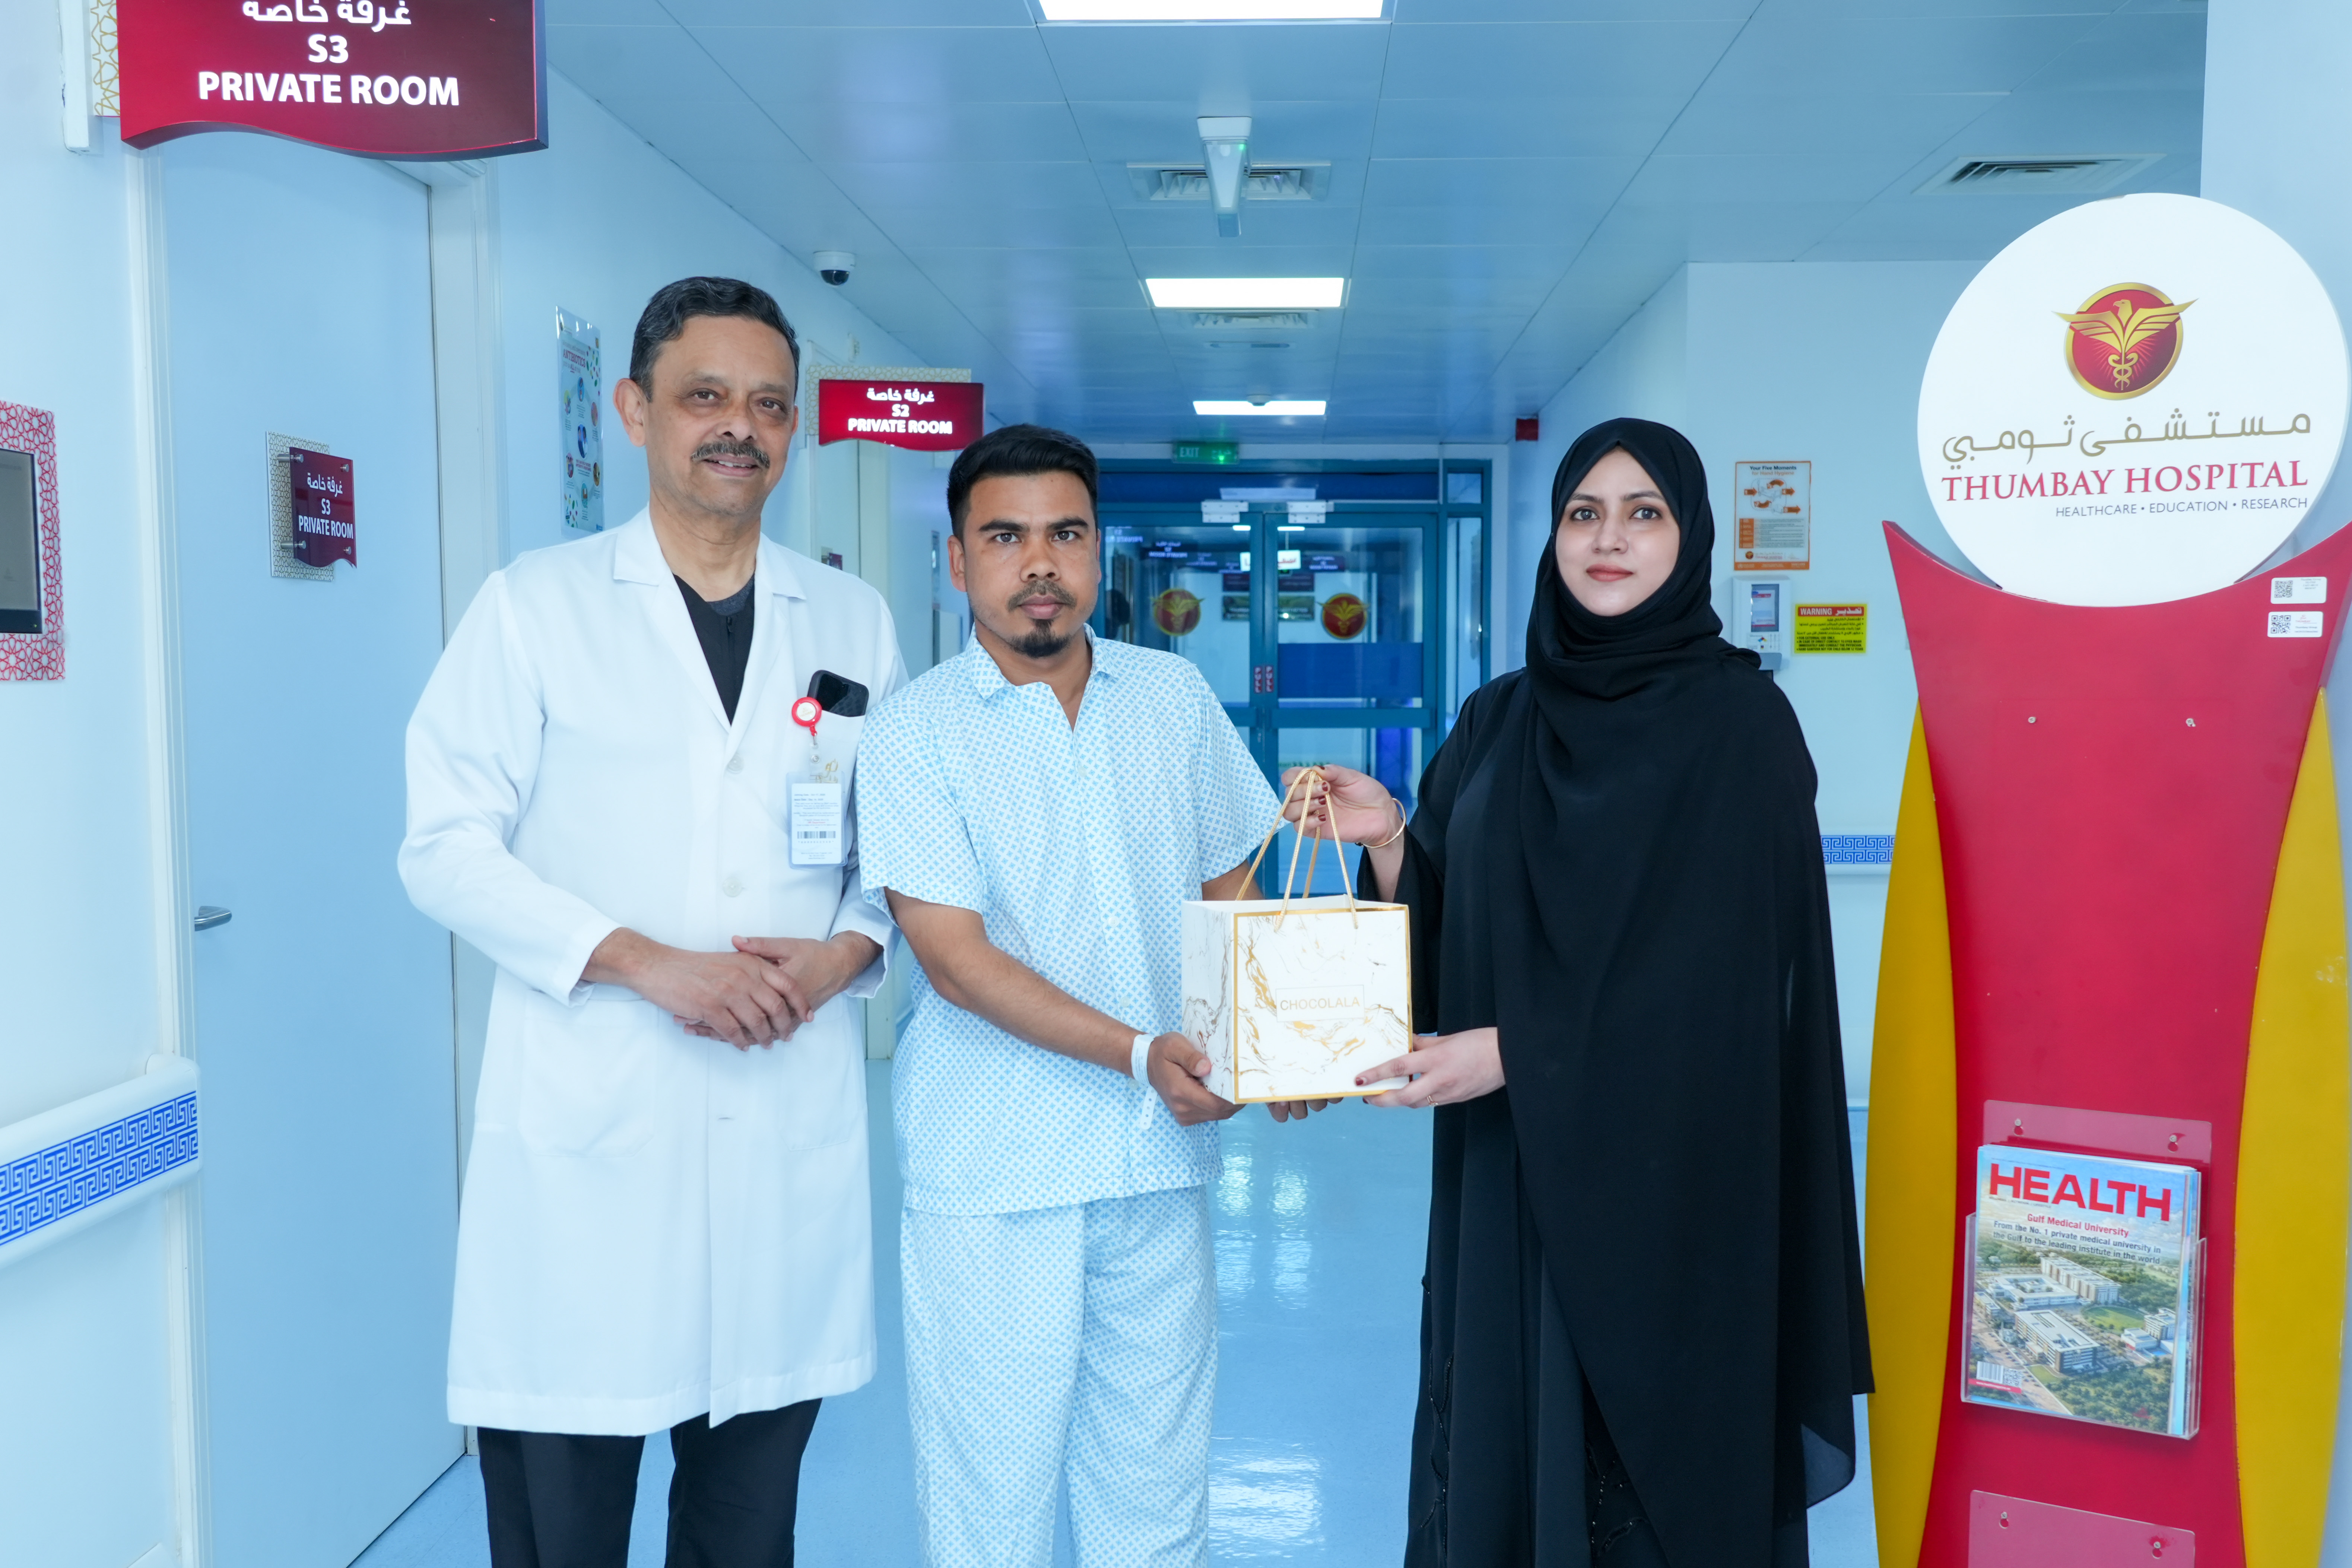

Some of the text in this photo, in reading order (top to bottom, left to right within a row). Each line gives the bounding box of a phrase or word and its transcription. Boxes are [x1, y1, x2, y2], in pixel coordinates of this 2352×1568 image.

[308, 34, 349, 63] S3
[198, 72, 459, 105] PRIVATE ROOM
[563, 349, 586, 368] ANTIBIOTICS
[867, 387, 934, 405] غرفة خاصة
[892, 404, 910, 417] S2
[848, 418, 953, 434] PRIVATE ROOM
[1942, 408, 2310, 470] مستشفى ثومبي
[1180, 447, 1199, 458] EXIT
[307, 472, 343, 497] غرفة خاصة
[1941, 460, 2308, 501] THUMBAY HOSPITAL
[321, 498, 331, 515] S3
[2056, 497, 2308, 517] HEALTHCARE EDUCATION RESEARCH
[299, 515, 353, 539] PRIVATE ROOM
[1835, 607, 1862, 616] تحذير
[1280, 996, 1360, 1010] CHOCOLALA
[1990, 1163, 2171, 1222] HEALTH
[1994, 1221, 2012, 1230] From
[2029, 1226, 2041, 1234] No.
[2051, 1231, 2078, 1240] private
[2080, 1234, 2110, 1245] medical
[2113, 1240, 2151, 1253] university
[2028, 1213, 2129, 1238] Gulf Medical University
[2007, 1233, 2022, 1242] Gulf
[2049, 1240, 2076, 1252] leading
[2079, 1244, 2111, 1256] institute
[2123, 1252, 2135, 1260] the
[2138, 1256, 2160, 1264] world
